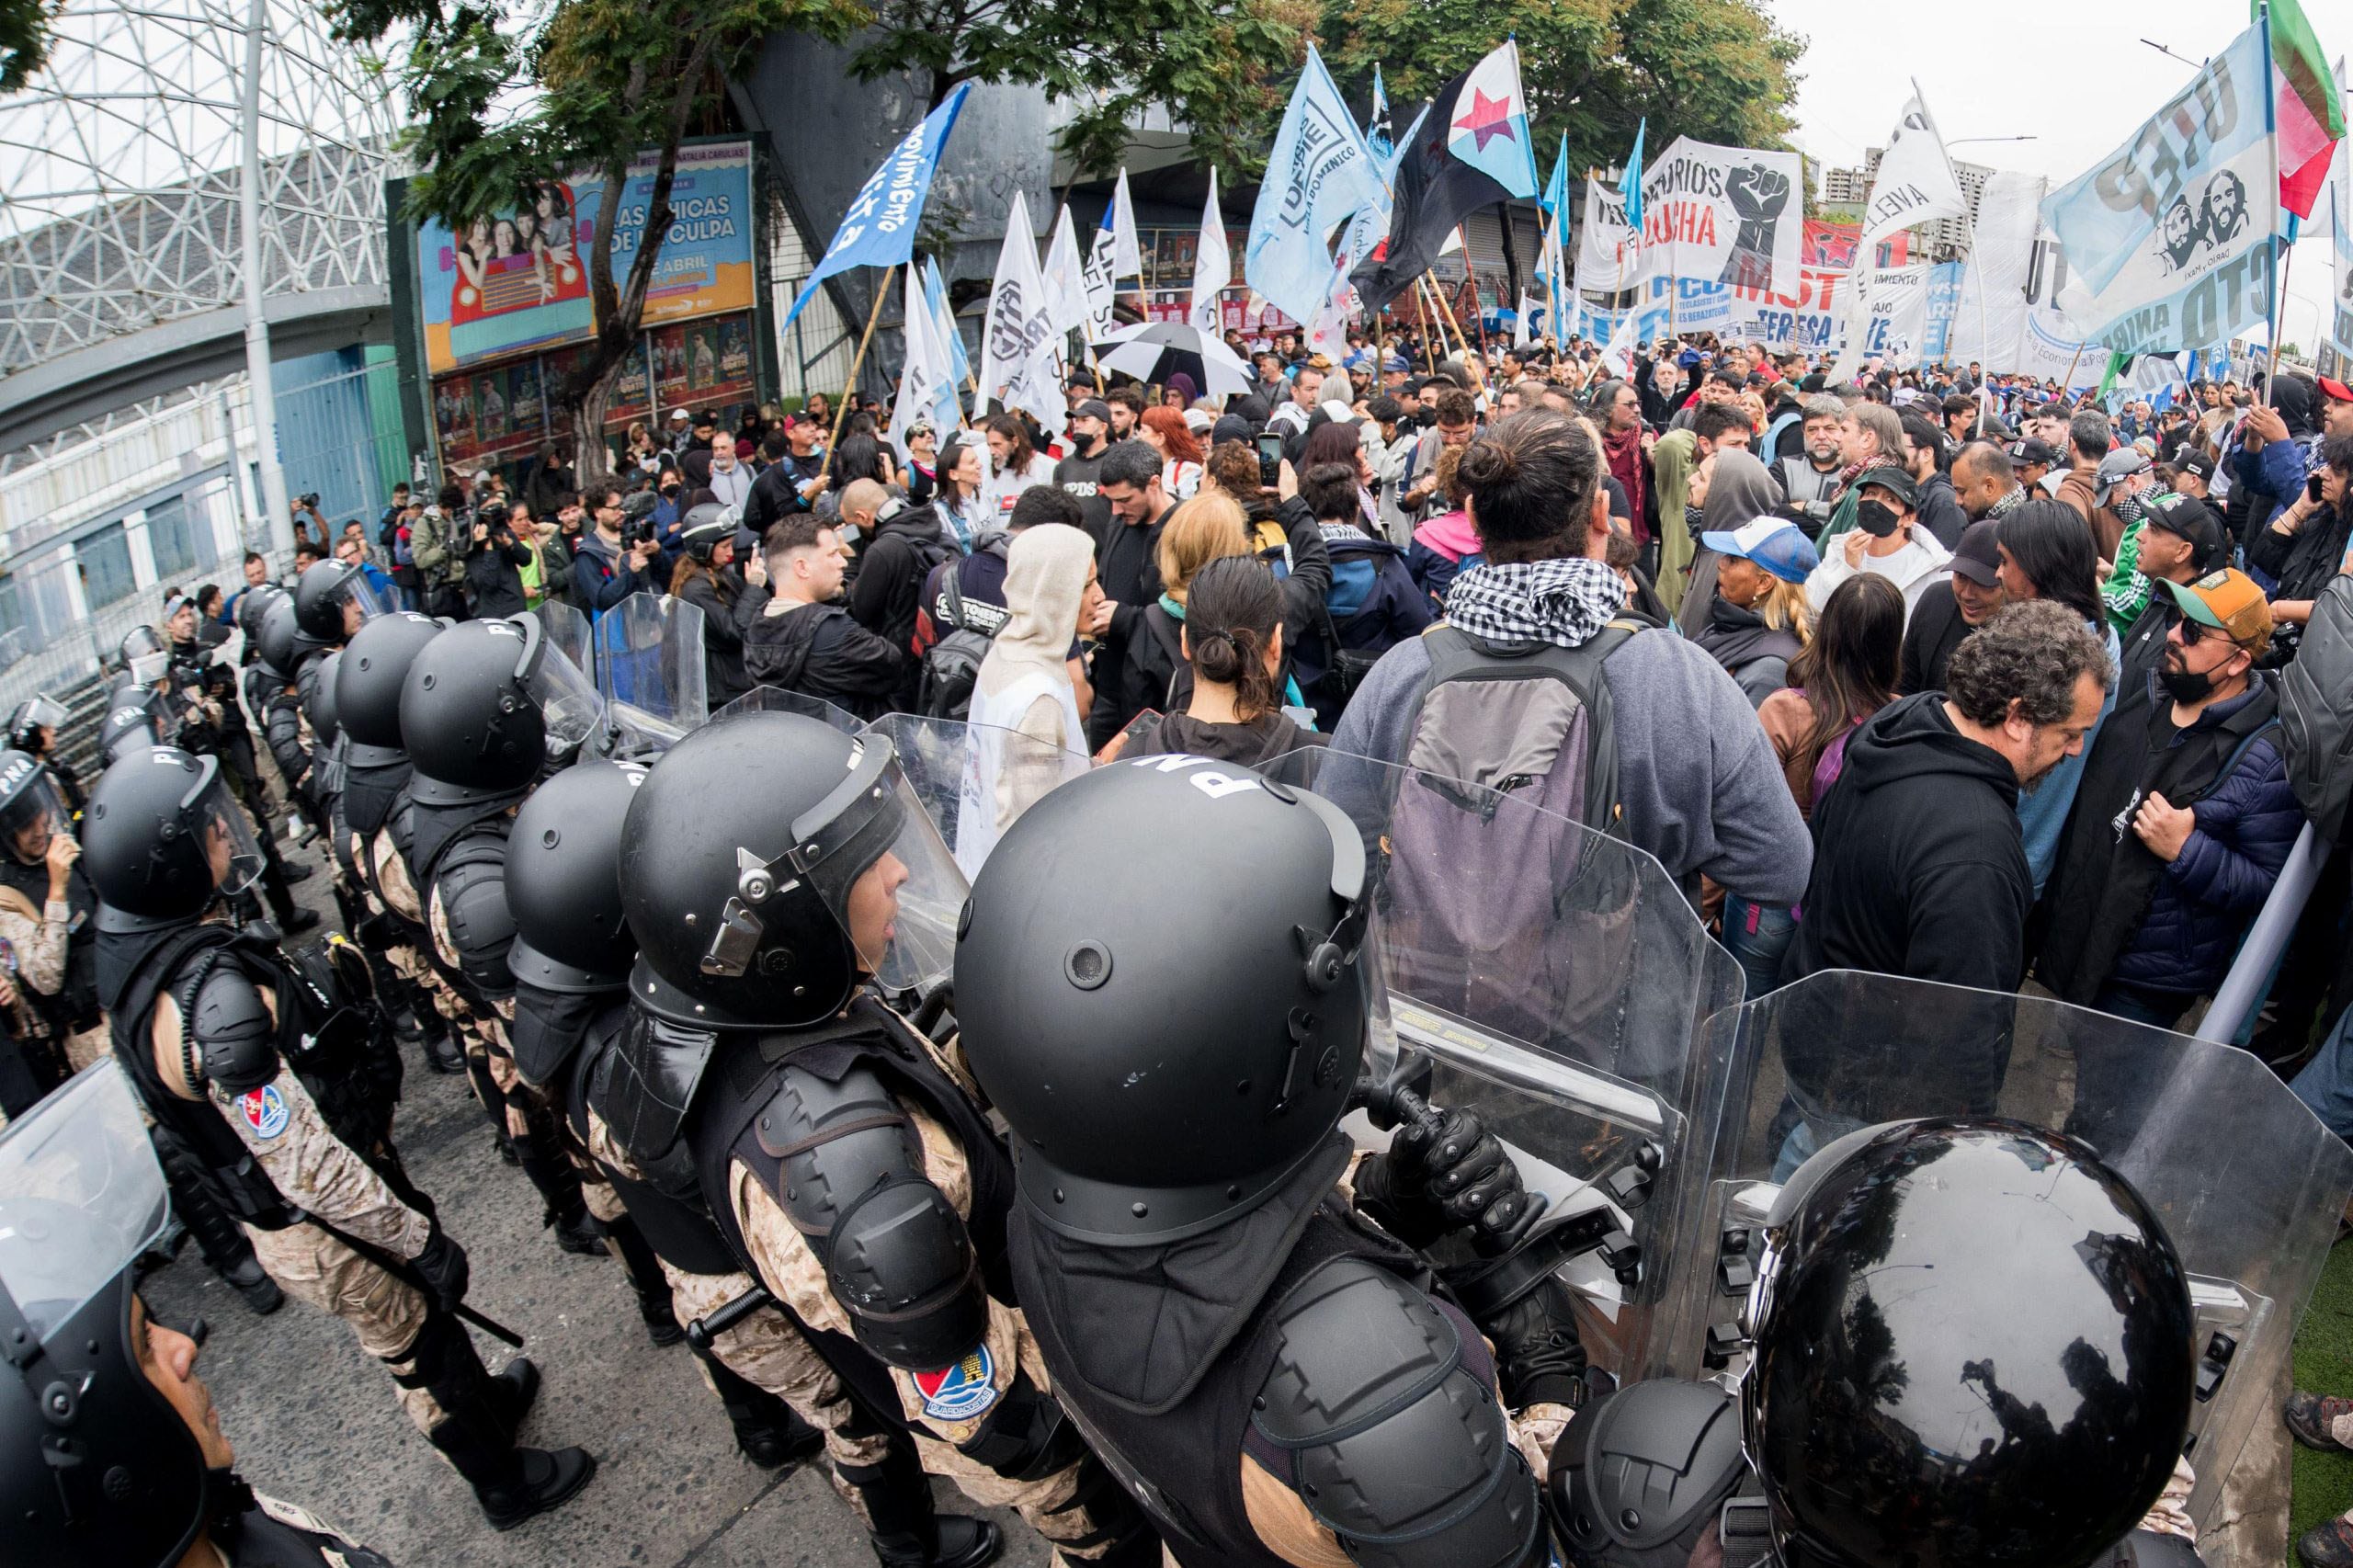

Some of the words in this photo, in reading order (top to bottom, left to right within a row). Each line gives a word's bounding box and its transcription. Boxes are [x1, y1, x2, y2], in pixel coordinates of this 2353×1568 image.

[613, 206, 645, 229] AS
[668, 196, 730, 222] HICAS
[668, 218, 735, 244] CULPA
[664, 255, 709, 273] ABRIL
[1757, 309, 1833, 347] TERESA
[113, 706, 146, 727] PNA
[0, 758, 34, 795] PNA
[1131, 754, 1261, 799] PN
[930, 1390, 992, 1415] GUARDACOSTAS
